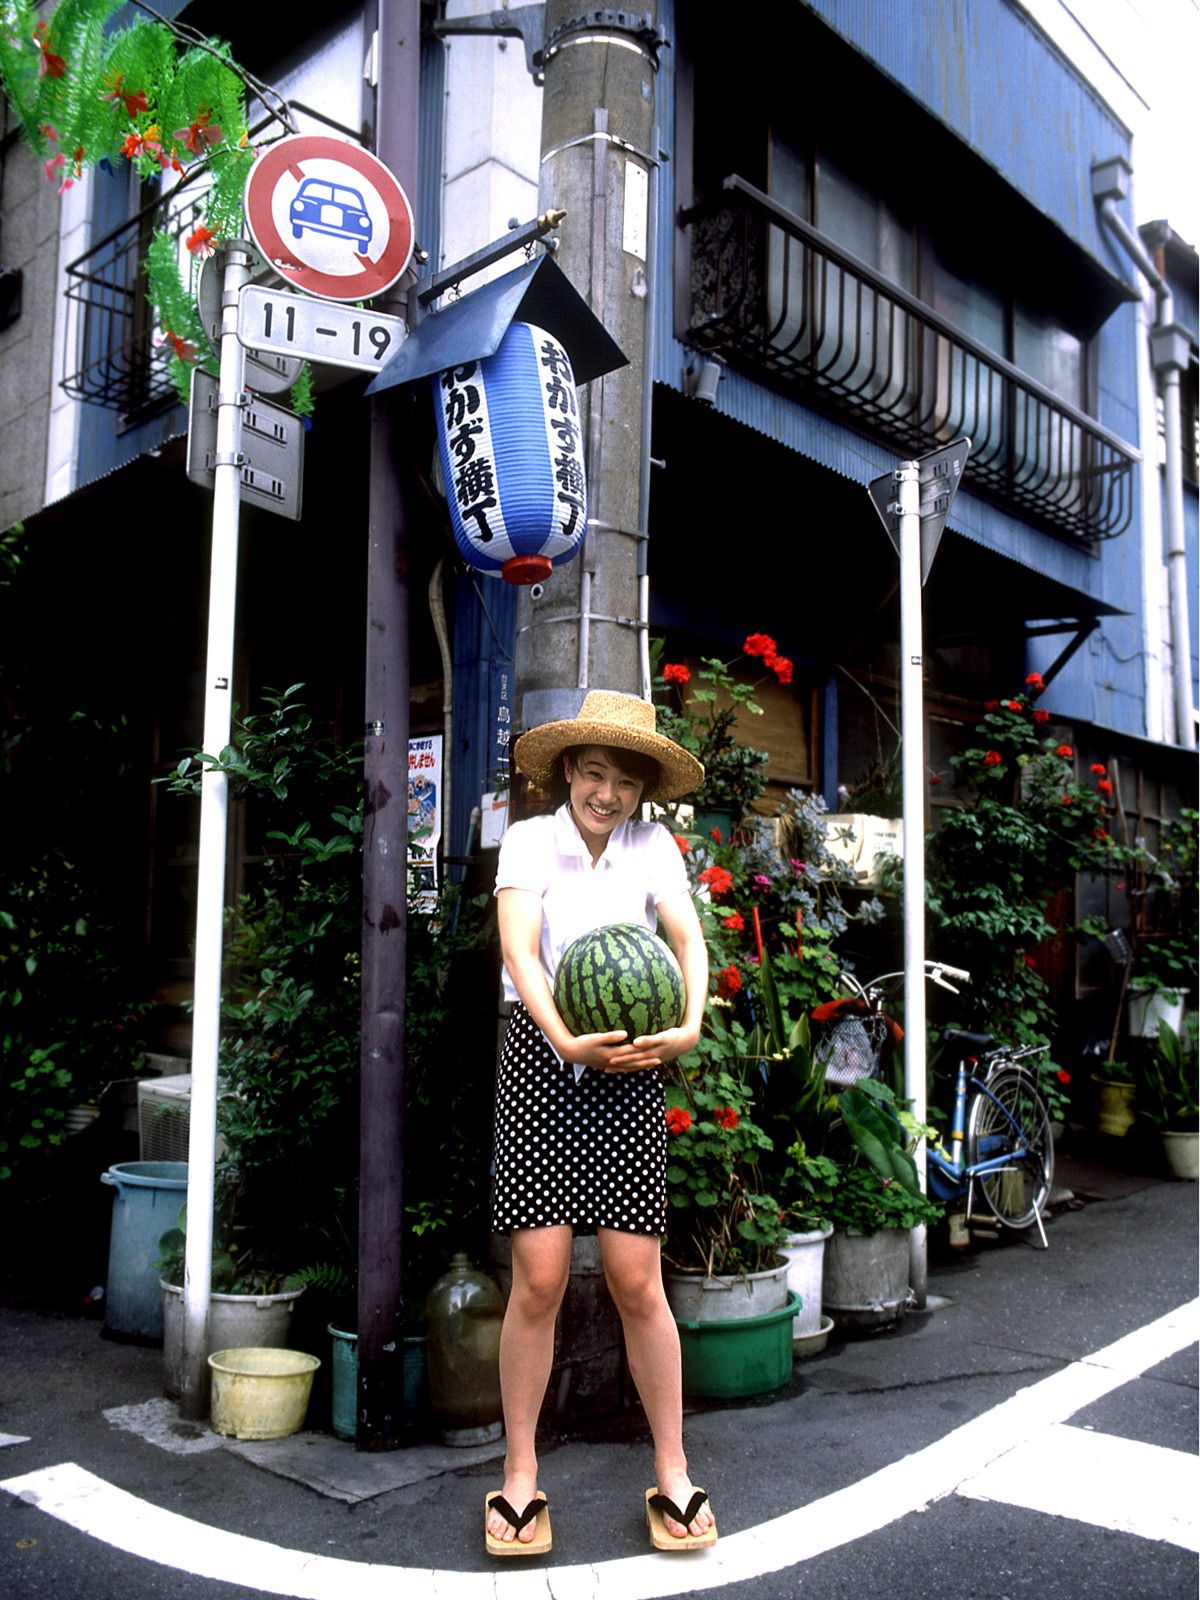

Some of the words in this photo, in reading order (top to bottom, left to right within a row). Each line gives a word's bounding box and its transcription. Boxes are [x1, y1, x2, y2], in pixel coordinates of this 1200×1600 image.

[541, 340, 585, 536] おかず横丁
